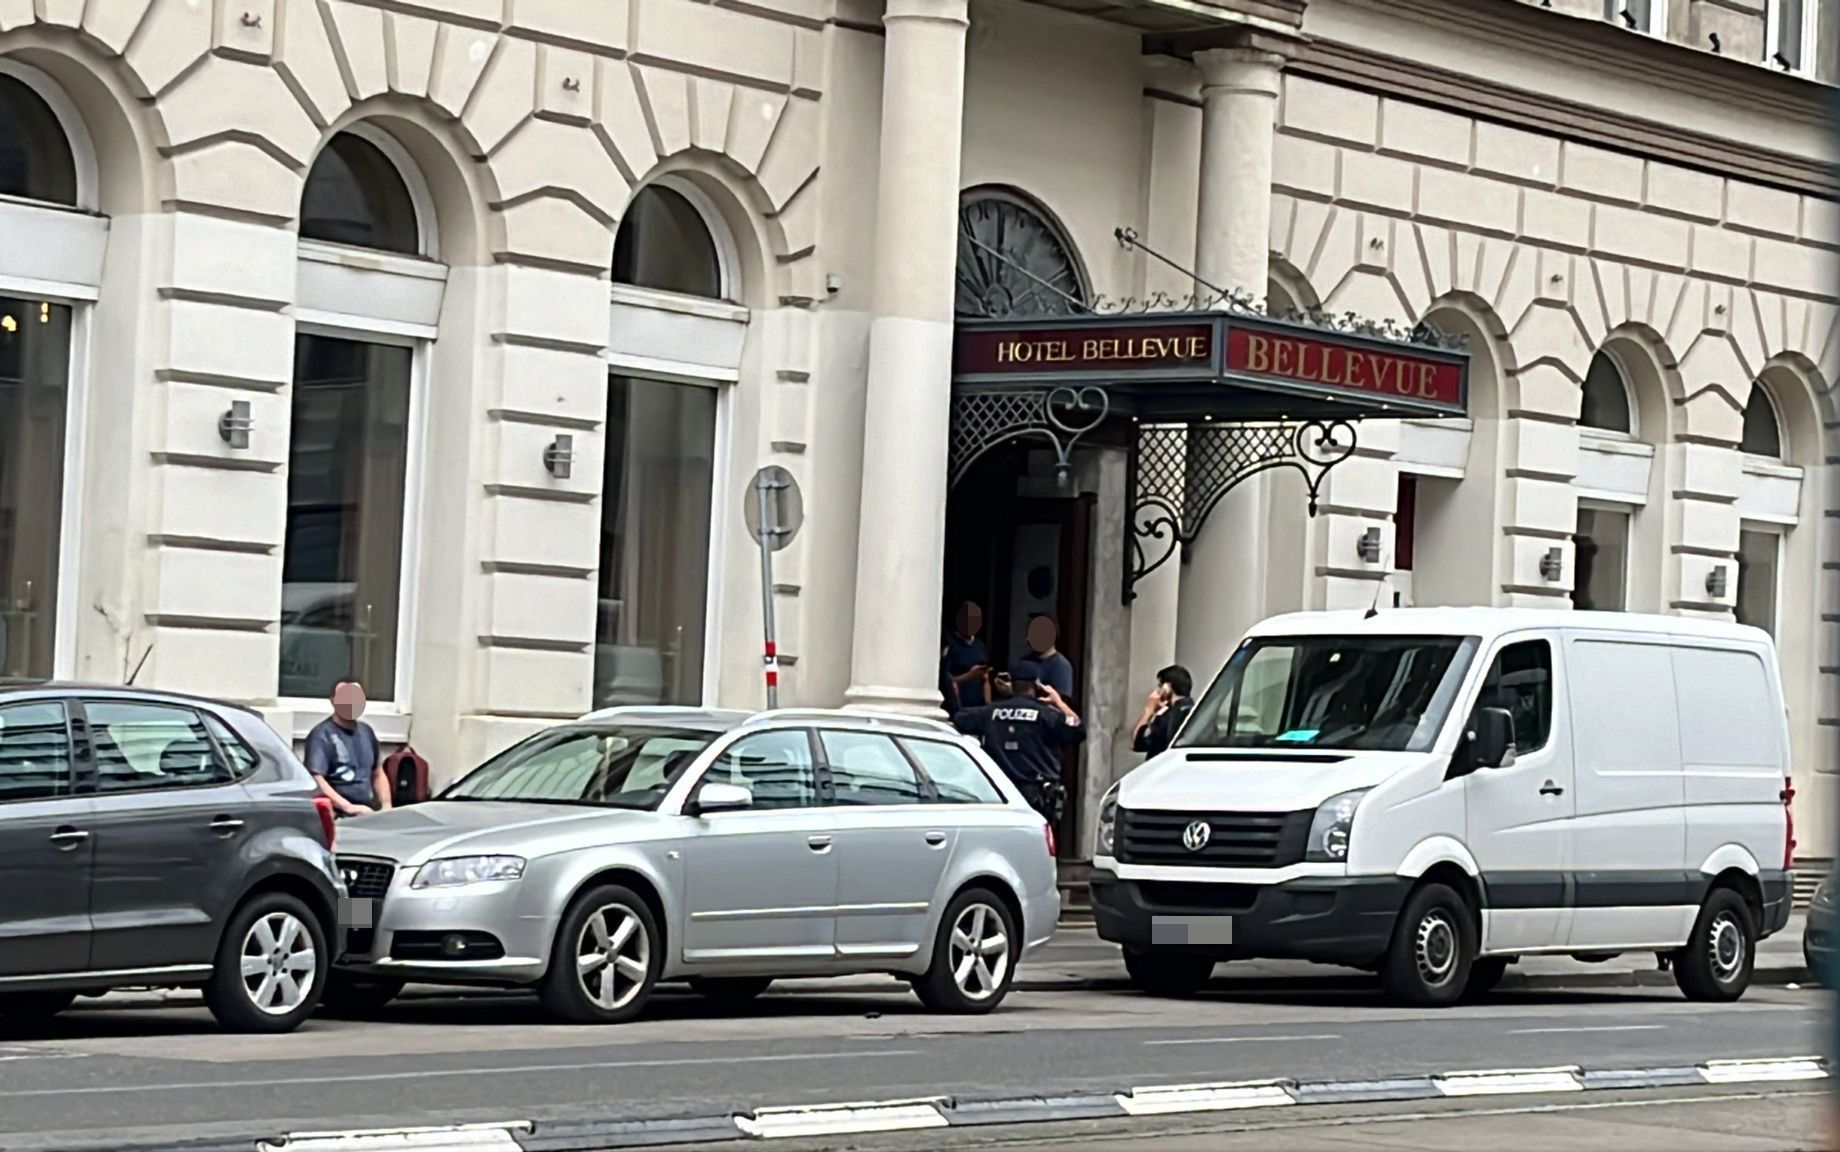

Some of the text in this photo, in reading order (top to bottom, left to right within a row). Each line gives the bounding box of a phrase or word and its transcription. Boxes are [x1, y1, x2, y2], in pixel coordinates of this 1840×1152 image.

[997, 337, 1207, 362] HOTEL BELLEVUE
[1246, 335, 1438, 399] BELLEVUE
[992, 708, 1039, 722] POLIZEI
